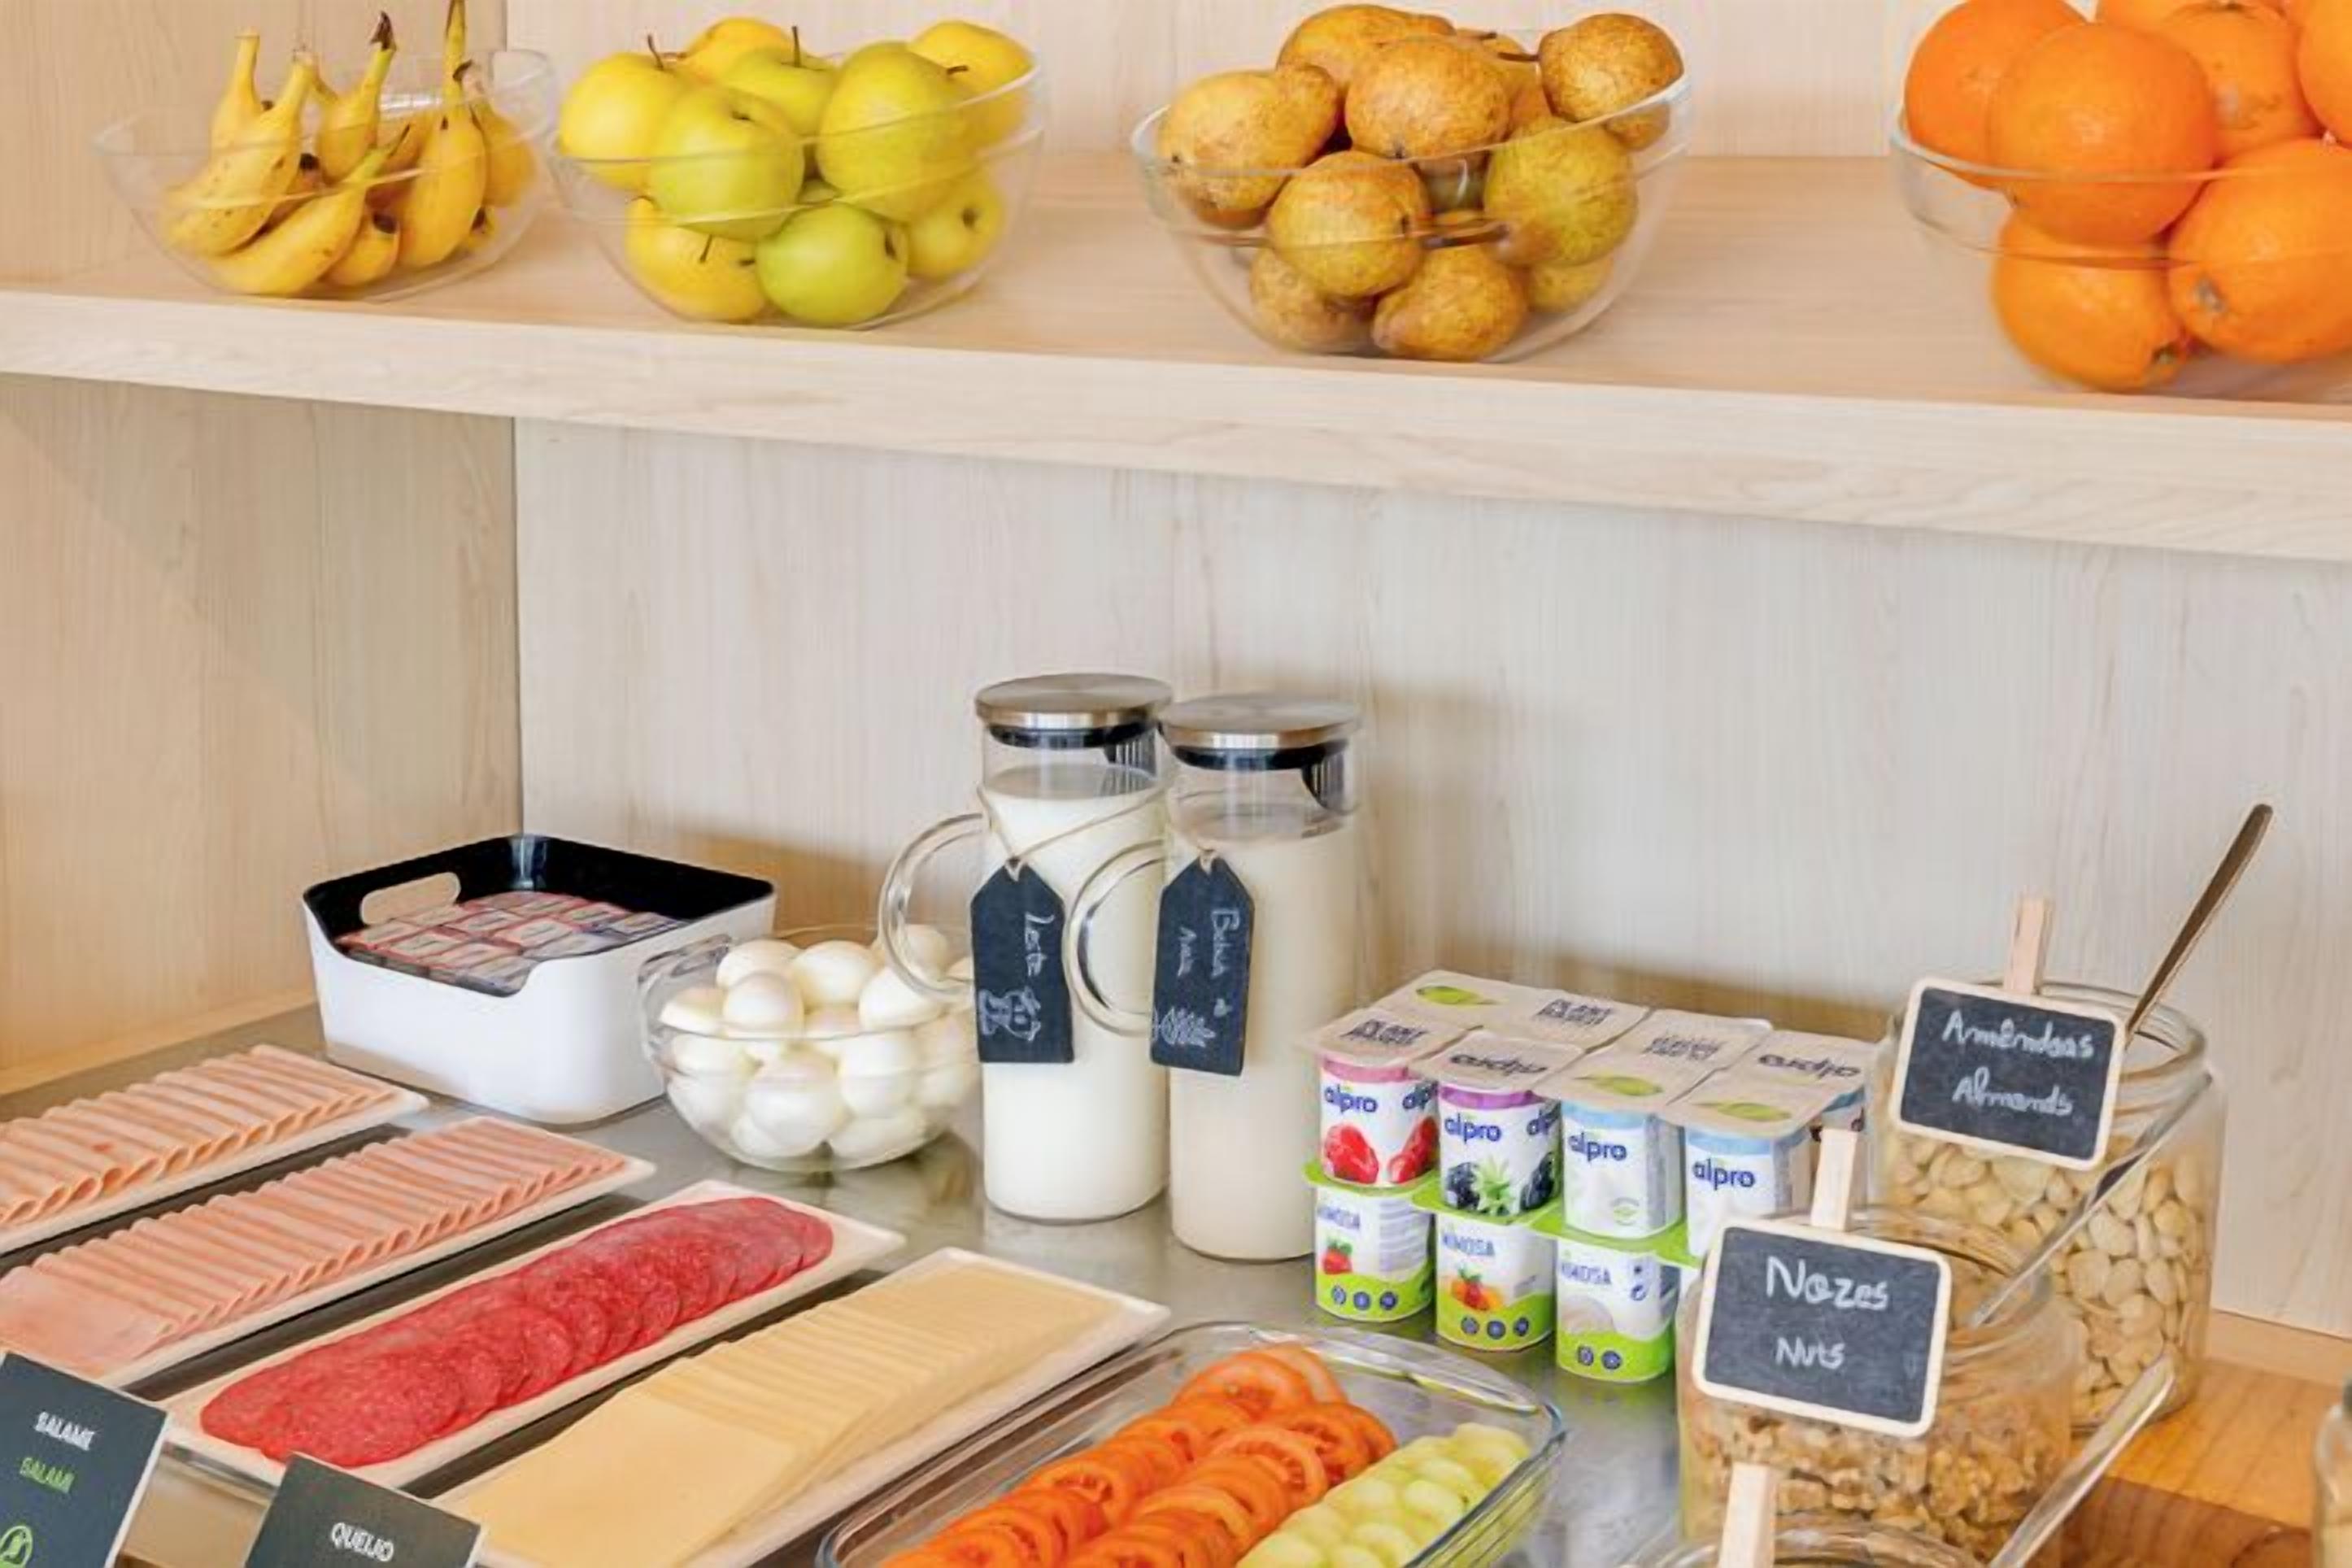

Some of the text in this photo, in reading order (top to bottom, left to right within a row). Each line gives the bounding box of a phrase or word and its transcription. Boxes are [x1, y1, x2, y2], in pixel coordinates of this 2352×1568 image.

[1324, 1083, 1378, 1113] alpro
[1952, 1066, 2073, 1117] Almonds
[1444, 1113, 1502, 1144] alpro
[1568, 1131, 1628, 1161] alpro
[1692, 1158, 1756, 1191] alpro
[1775, 1336, 1847, 1370] Nuts
